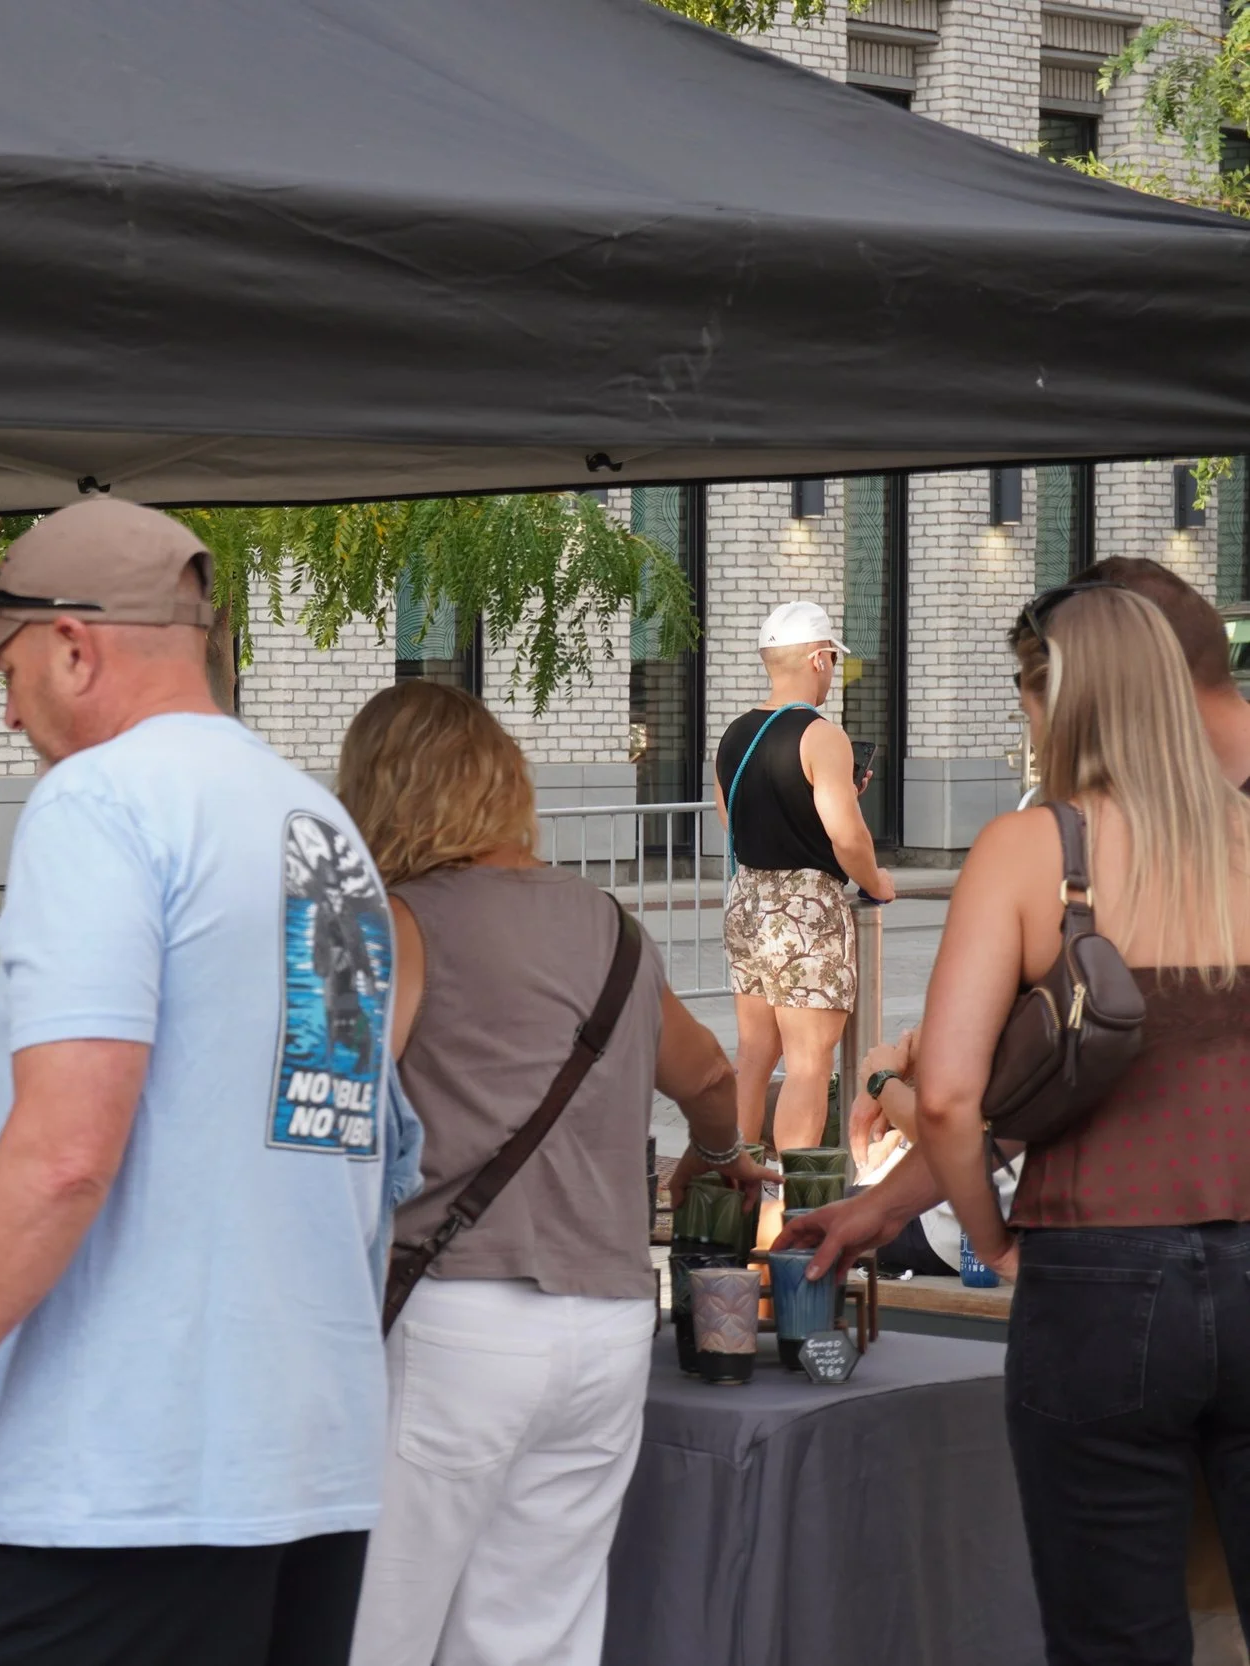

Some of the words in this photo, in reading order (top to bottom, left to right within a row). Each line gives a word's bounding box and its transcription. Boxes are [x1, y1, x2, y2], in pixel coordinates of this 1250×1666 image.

[286, 1070, 331, 1104] NO
[288, 1105, 335, 1138] NO
[818, 1366, 842, 1377] $60
